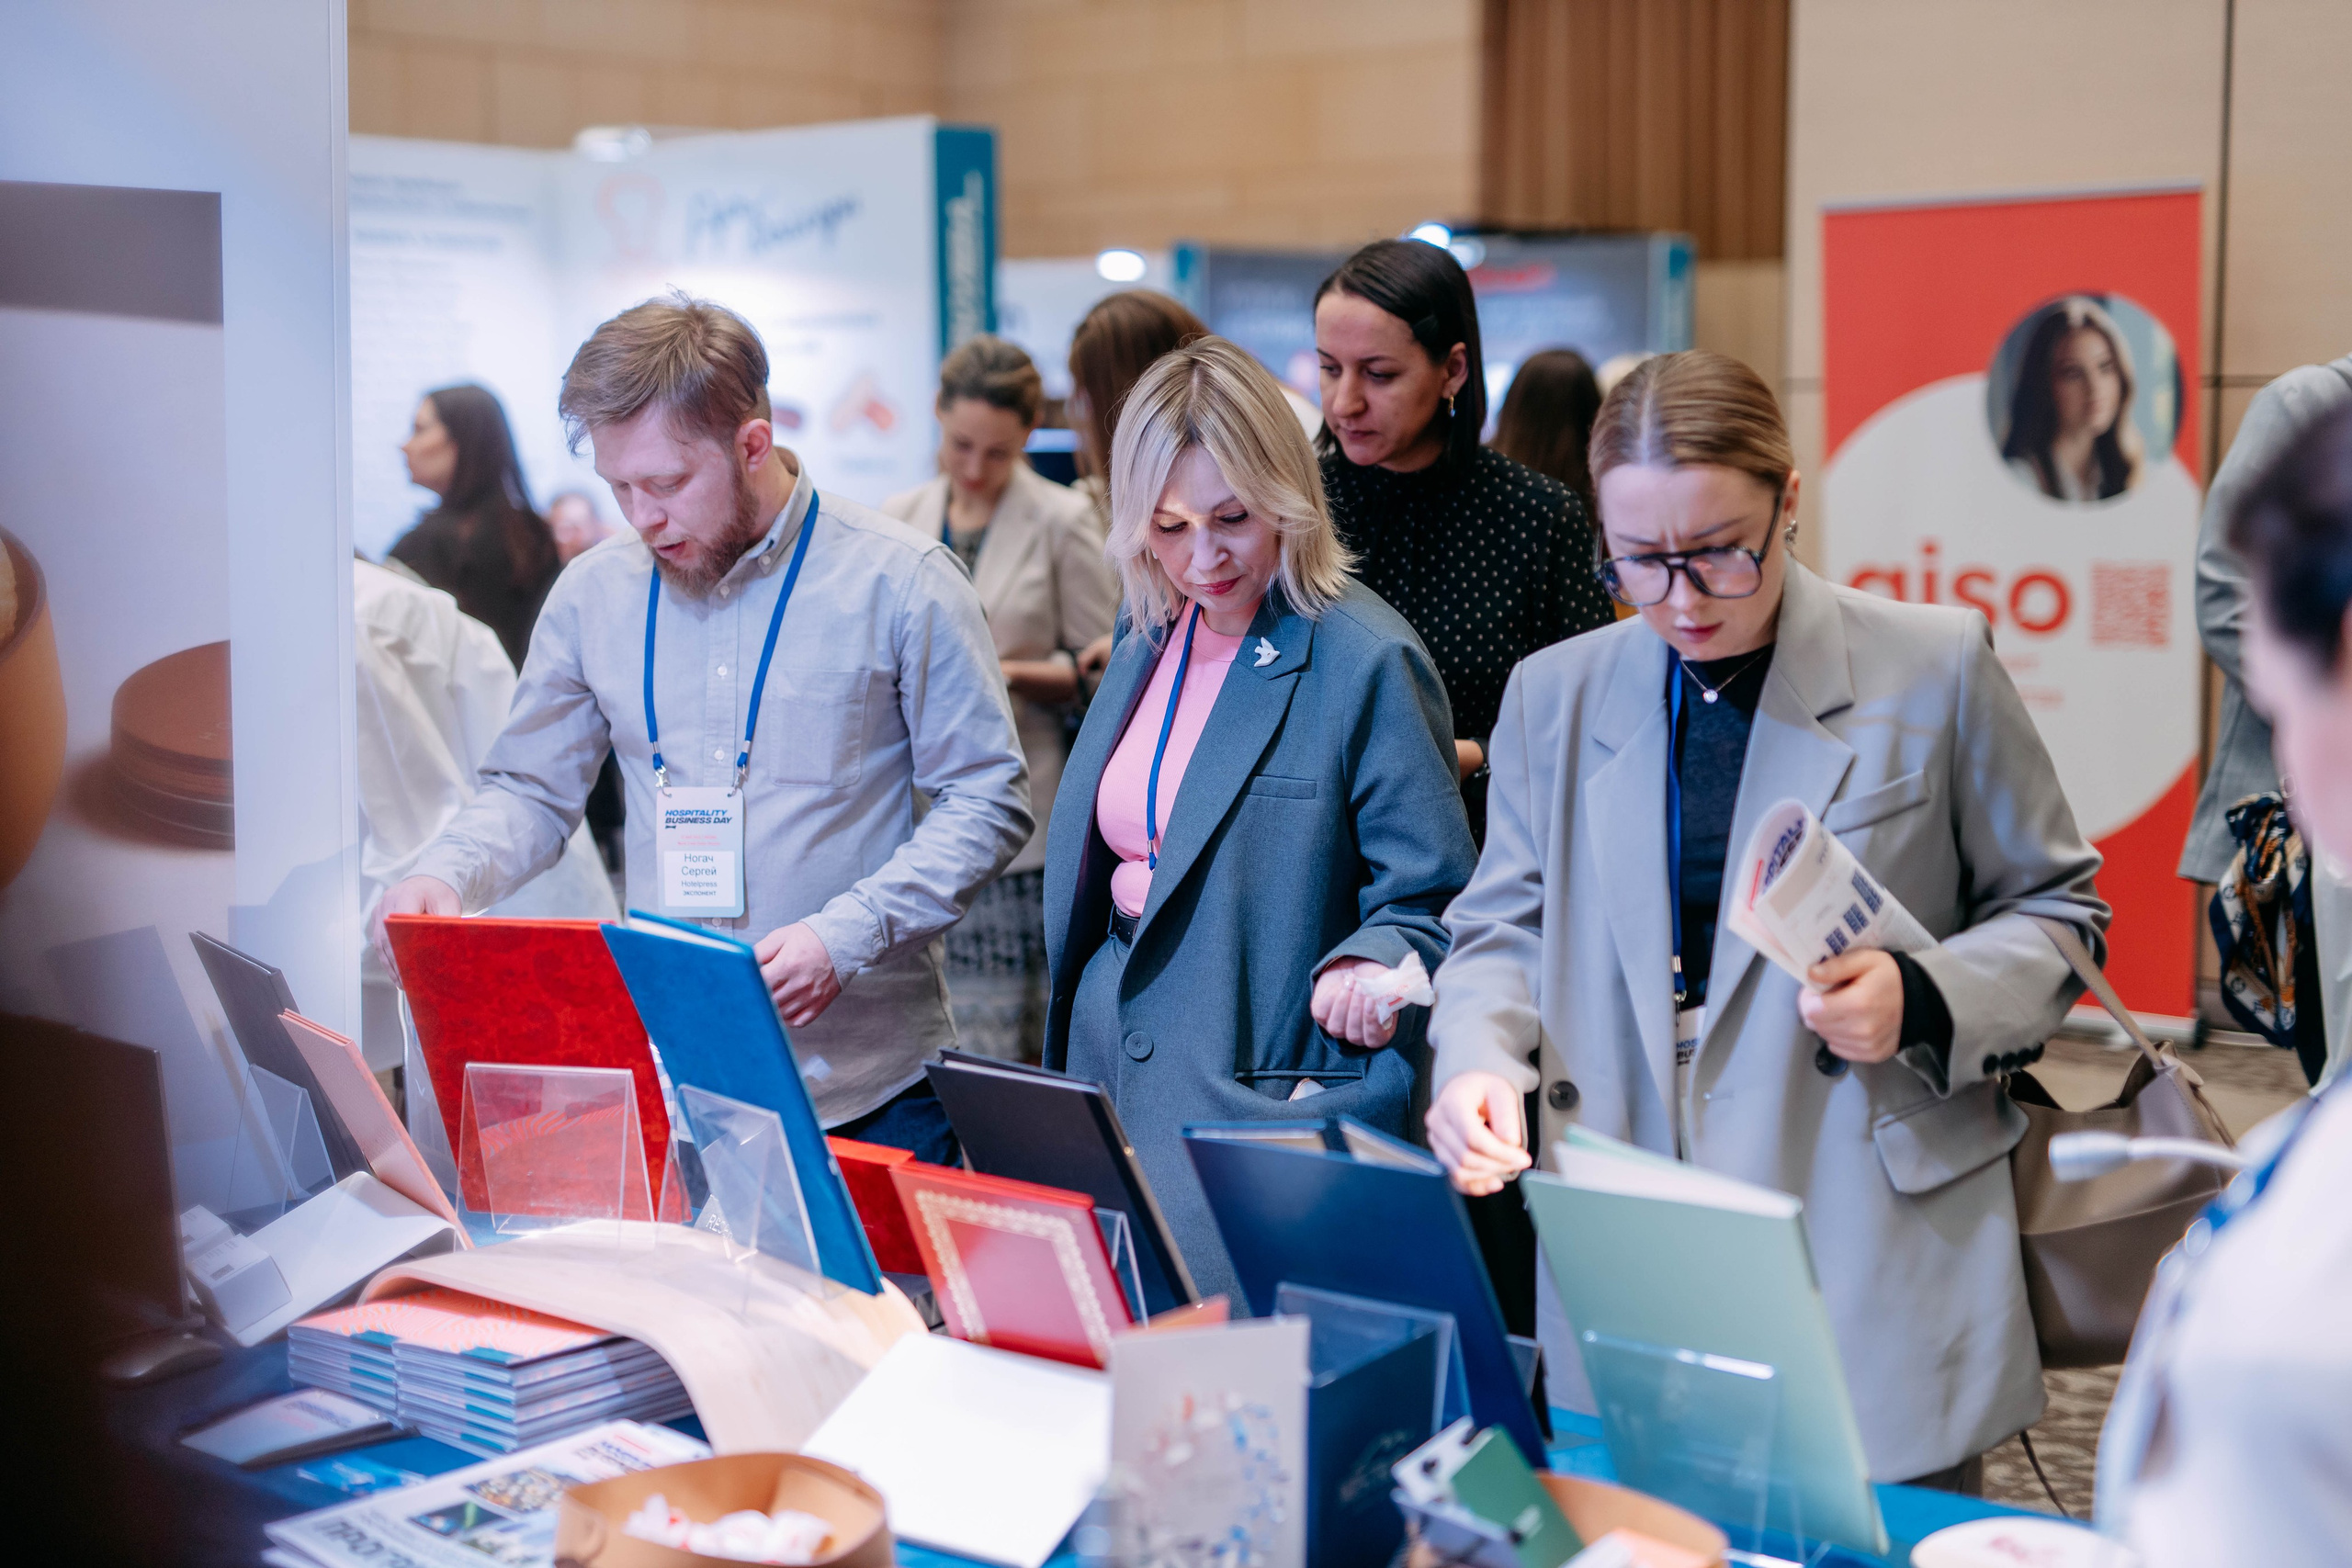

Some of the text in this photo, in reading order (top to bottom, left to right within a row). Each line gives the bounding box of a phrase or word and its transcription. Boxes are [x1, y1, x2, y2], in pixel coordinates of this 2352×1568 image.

[684, 853, 714, 863] Ногач
[681, 866, 717, 877] Сергей
[681, 880, 718, 888] Hotelpress
